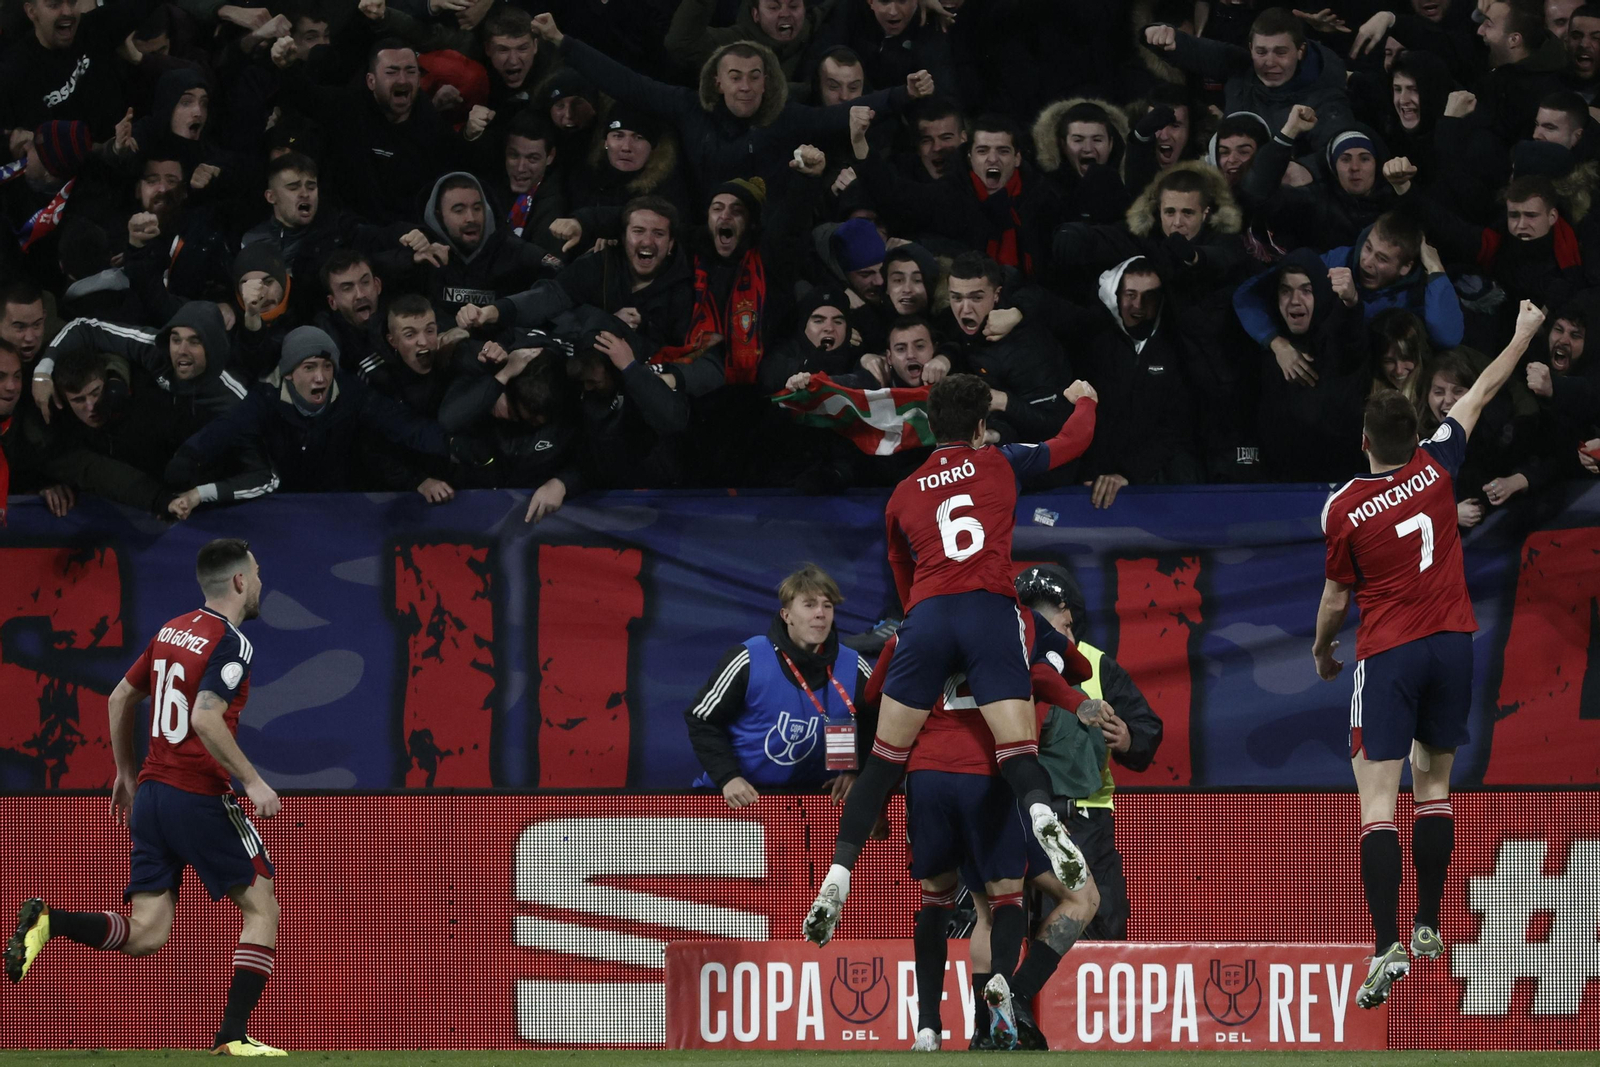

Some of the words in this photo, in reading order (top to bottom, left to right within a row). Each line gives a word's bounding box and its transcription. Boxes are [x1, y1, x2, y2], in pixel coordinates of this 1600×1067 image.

[443, 287, 494, 304] NORWAY
[917, 459, 976, 491] TORRÓ
[1347, 464, 1440, 527] MONCAYOLA
[936, 494, 985, 562] 6
[1395, 512, 1434, 573] 7
[152, 659, 189, 744] 16
[700, 961, 826, 1043] COPA
[842, 1029, 880, 1041] DEL
[1077, 962, 1199, 1044] COPA
[1215, 1032, 1252, 1043] DEL
[1269, 963, 1353, 1043] REY
